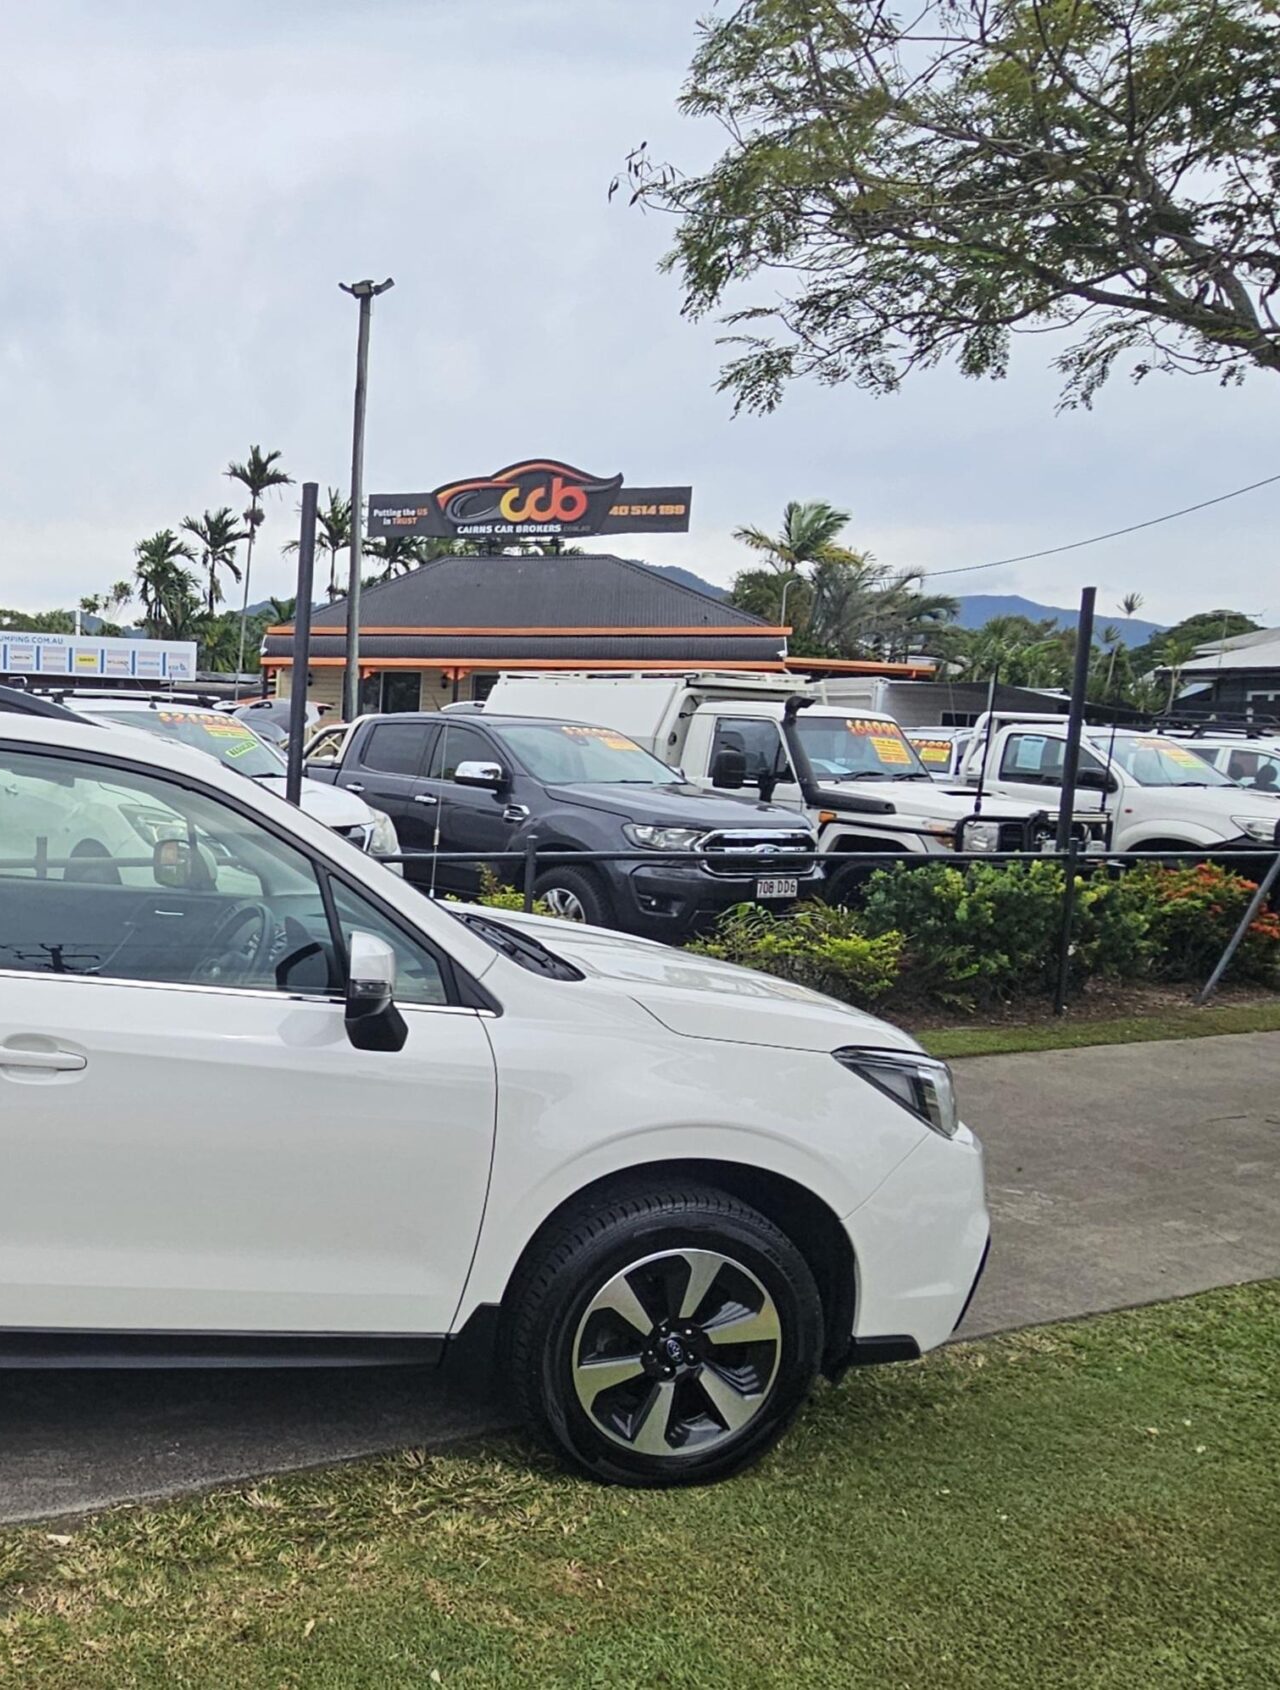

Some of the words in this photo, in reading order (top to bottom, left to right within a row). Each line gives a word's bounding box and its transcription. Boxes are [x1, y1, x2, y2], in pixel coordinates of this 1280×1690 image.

[403, 508, 416, 516] the
[457, 525, 492, 534] CAIRNS
[494, 525, 513, 533] CAR
